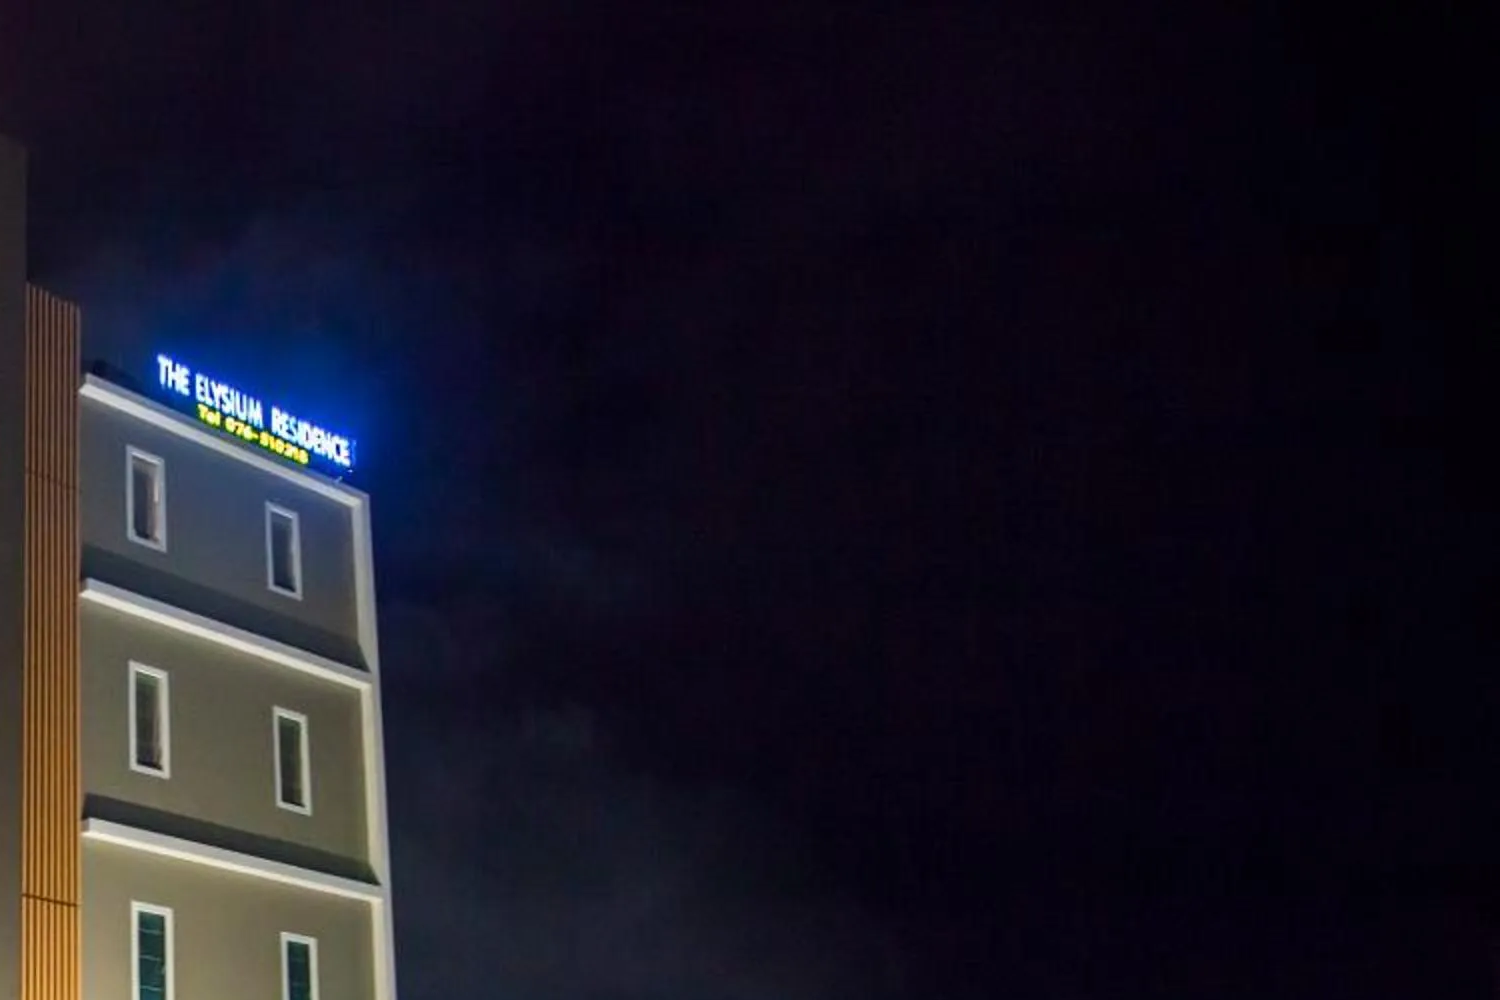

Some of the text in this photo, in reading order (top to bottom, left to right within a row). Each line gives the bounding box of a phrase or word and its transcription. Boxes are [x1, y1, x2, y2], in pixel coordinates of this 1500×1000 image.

[157, 354, 350, 467] THE ELYSIUM RESIDENCE
[197, 403, 221, 426] Tel
